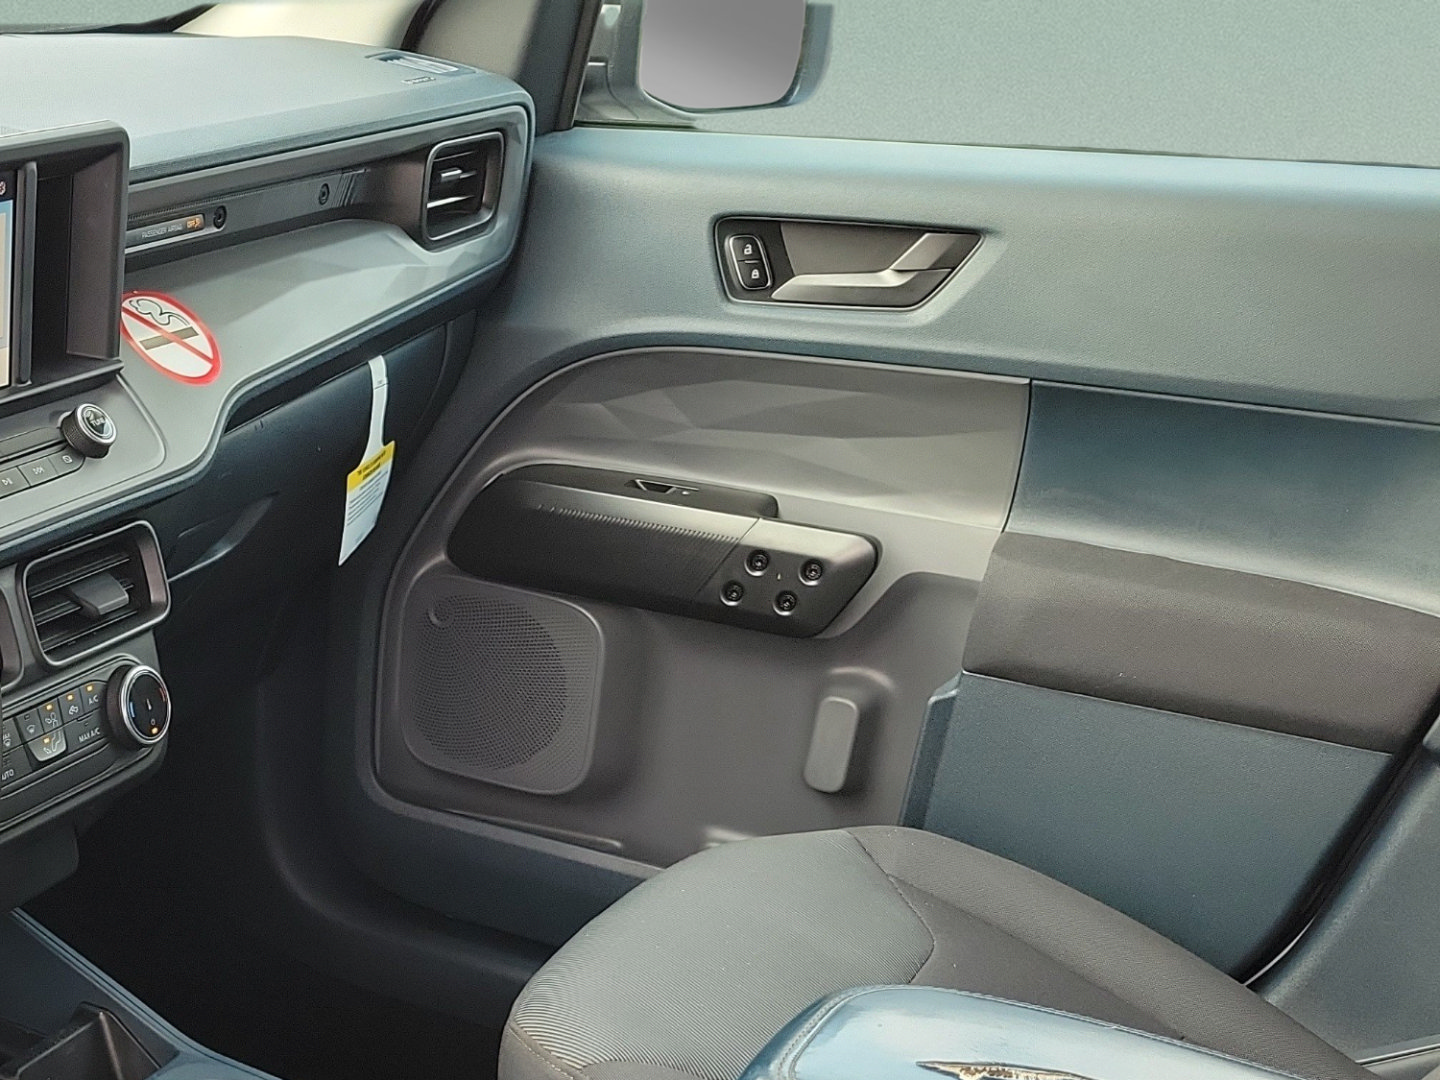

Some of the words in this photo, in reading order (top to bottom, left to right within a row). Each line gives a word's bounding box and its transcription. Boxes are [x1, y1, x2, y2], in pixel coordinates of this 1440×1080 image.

[88, 695, 99, 704] A/C
[78, 733, 90, 743] MAX
[2, 768, 15, 780] UTO
